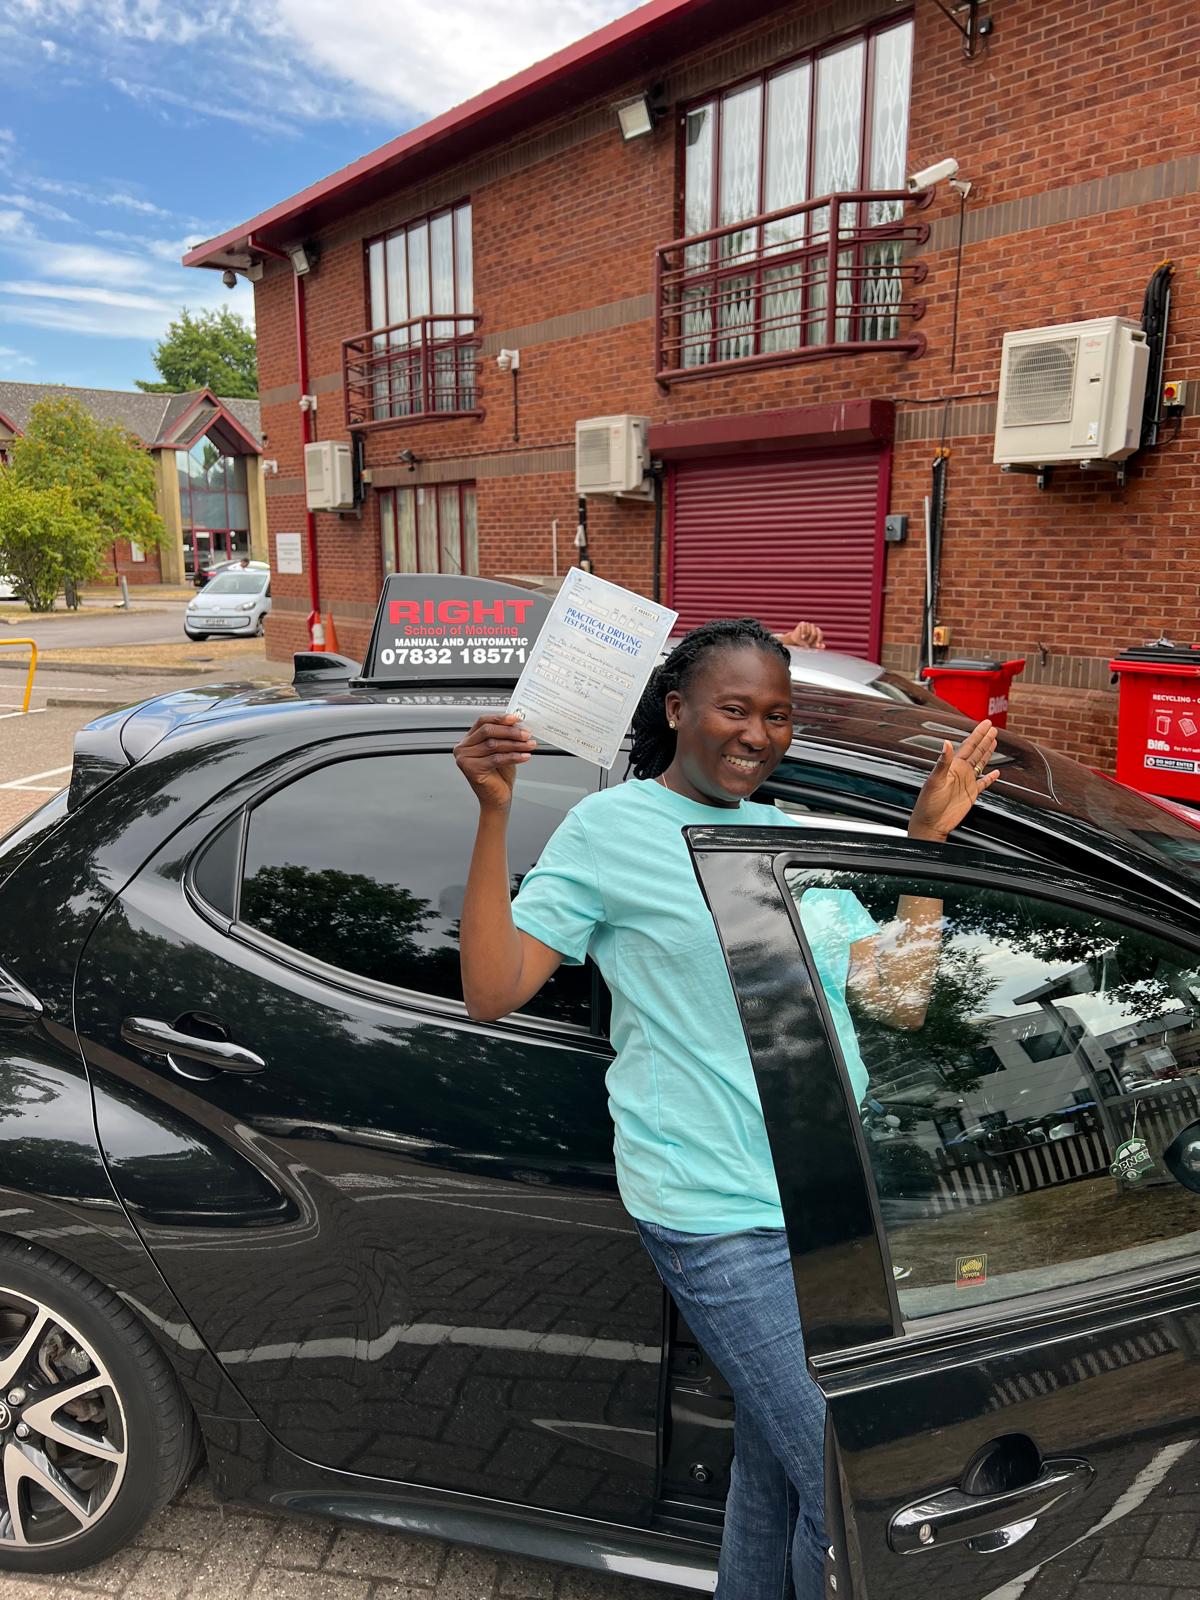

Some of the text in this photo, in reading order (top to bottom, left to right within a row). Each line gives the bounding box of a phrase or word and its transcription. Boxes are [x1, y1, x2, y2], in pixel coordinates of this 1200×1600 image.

[389, 600, 534, 624] RIGHT
[404, 625, 519, 636] School of Motoring
[566, 607, 606, 631] PRACTICAL
[606, 626, 643, 649] DRIVING
[394, 637, 529, 647] MANUAL AND AUTOMATIC
[563, 616, 578, 628] TEST
[579, 623, 595, 636] PASS
[595, 631, 640, 656] CERTIFICATE
[381, 649, 452, 664] 07832
[988, 695, 1008, 715] Biffa
[1152, 694, 1191, 703] RECYCLING
[1147, 739, 1170, 751] Biffa
